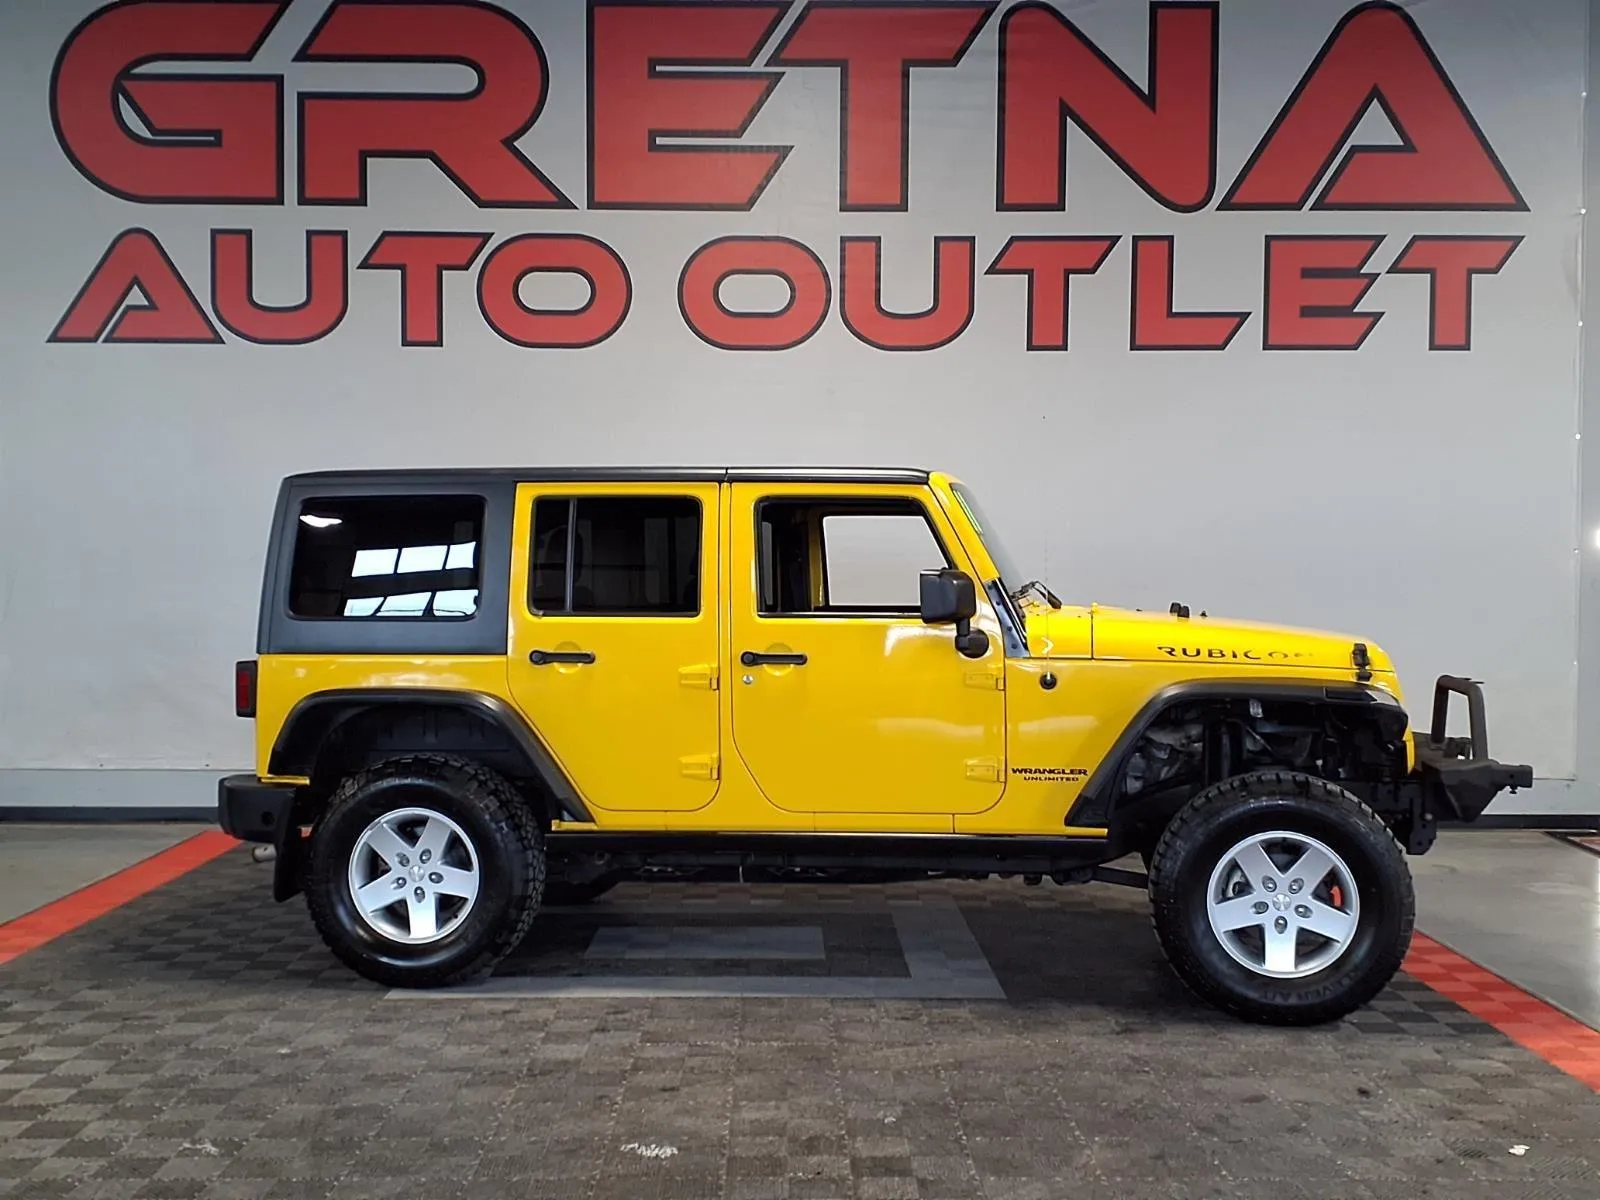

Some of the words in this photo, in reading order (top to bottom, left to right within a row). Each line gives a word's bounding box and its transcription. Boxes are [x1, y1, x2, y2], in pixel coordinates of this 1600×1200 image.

[50, 0, 1531, 213] GRETNA
[46, 228, 633, 349] AUTO
[678, 234, 1526, 352] OUTLET
[1010, 767, 1089, 777] WRANGLER
